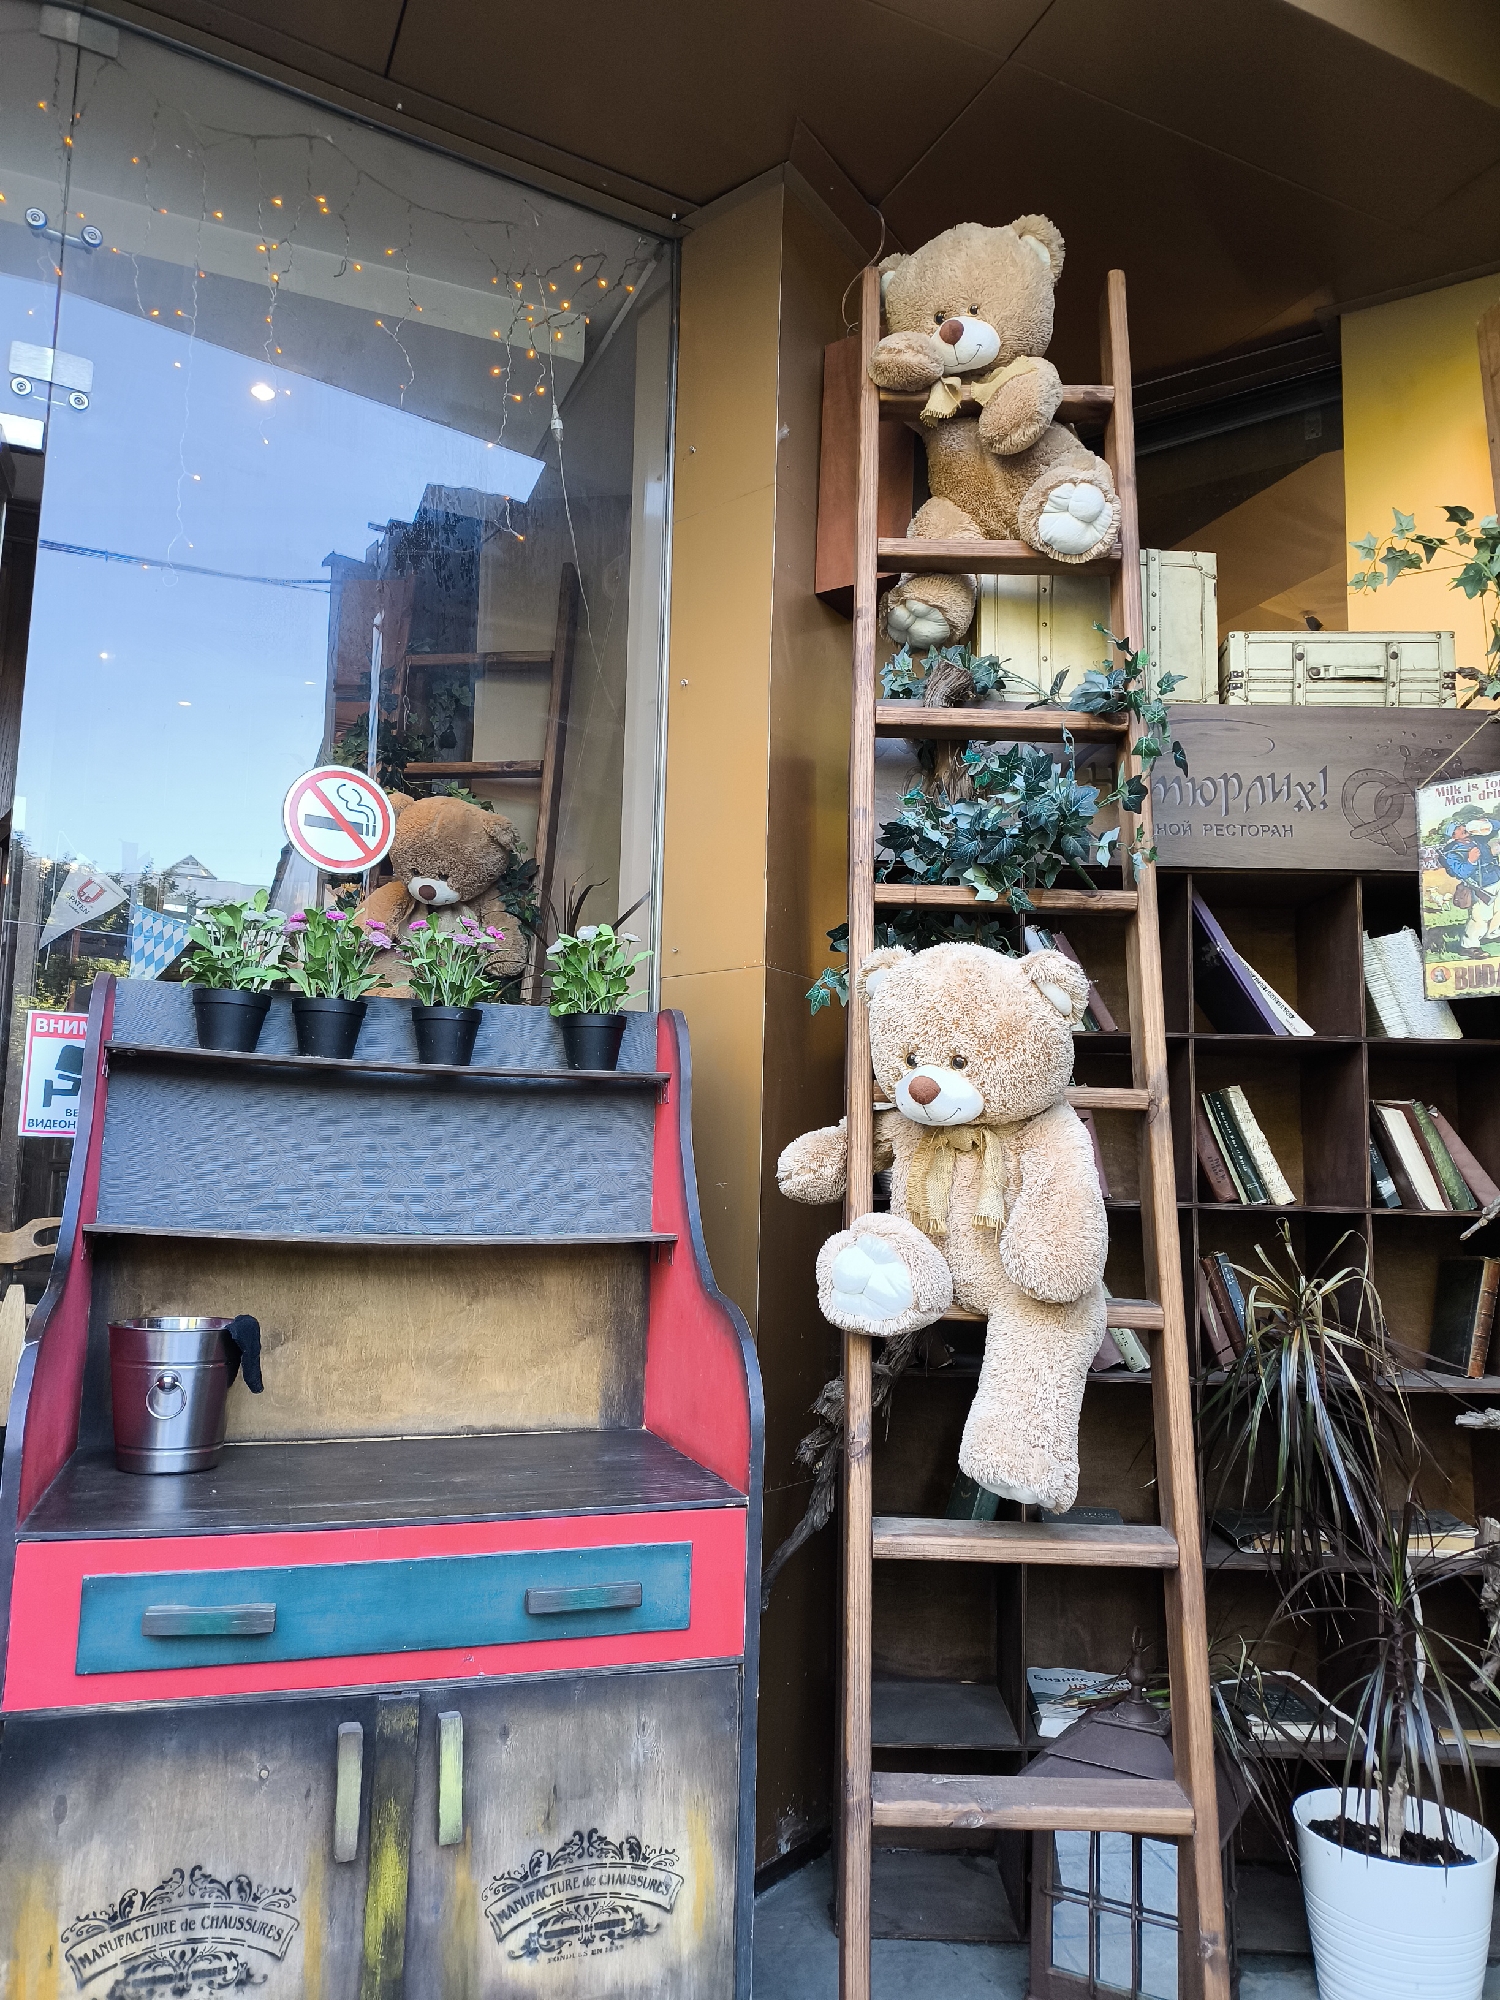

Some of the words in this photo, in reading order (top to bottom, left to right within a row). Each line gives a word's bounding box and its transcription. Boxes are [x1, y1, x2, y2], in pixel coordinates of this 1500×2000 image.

[1435, 784, 1462, 797] Milk
[1467, 782, 1479, 793] is
[1444, 794, 1472, 807] Men
[1478, 788, 1500, 801] dri
[1202, 823, 1294, 838] РЕСТОРАН
[497, 1875, 581, 1924] MANUFACTURE
[582, 1875, 596, 1888] de
[599, 1872, 671, 1896] CHAUSSURES
[77, 1918, 177, 1969] MANUFACTURE
[180, 1917, 196, 1932] de
[201, 1914, 284, 1942] CHAUSSURES
